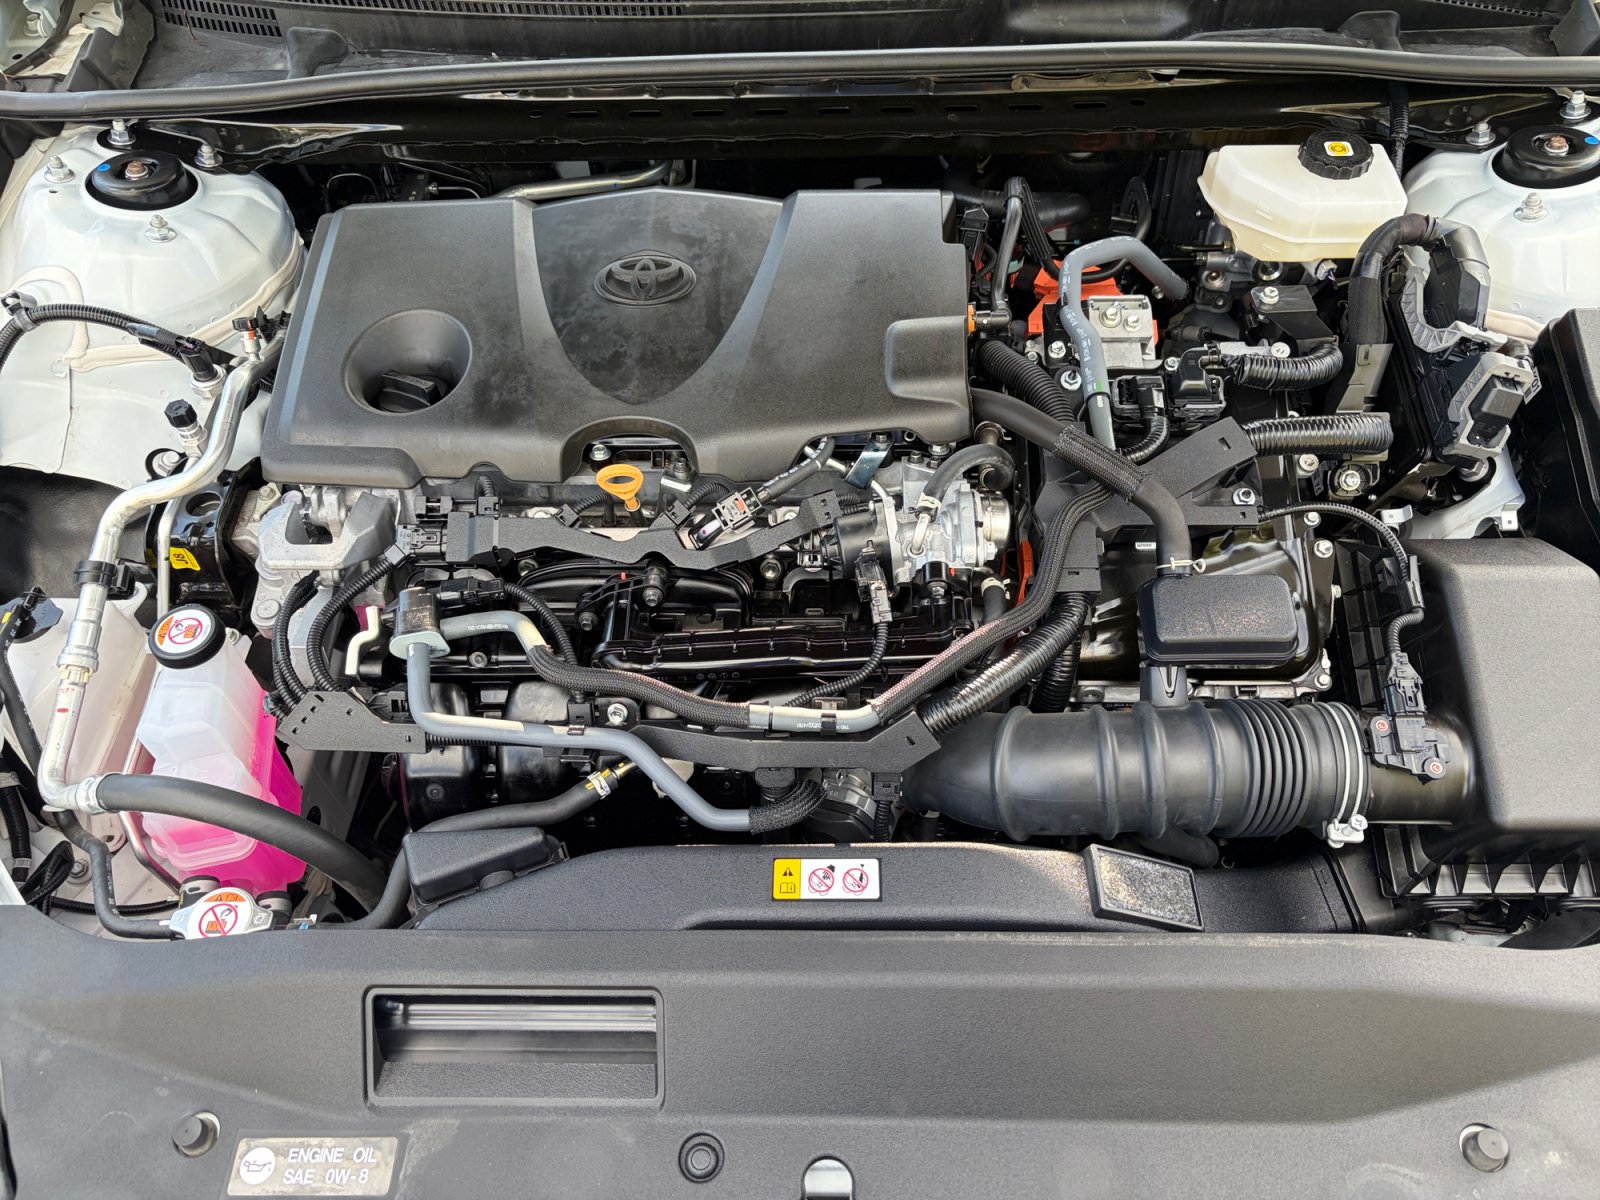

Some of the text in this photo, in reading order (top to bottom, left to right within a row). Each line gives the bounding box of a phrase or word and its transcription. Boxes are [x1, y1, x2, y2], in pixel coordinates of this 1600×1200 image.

[287, 1147, 377, 1163] ENGINE OIL
[283, 1168, 369, 1184] SAE 0W-8
